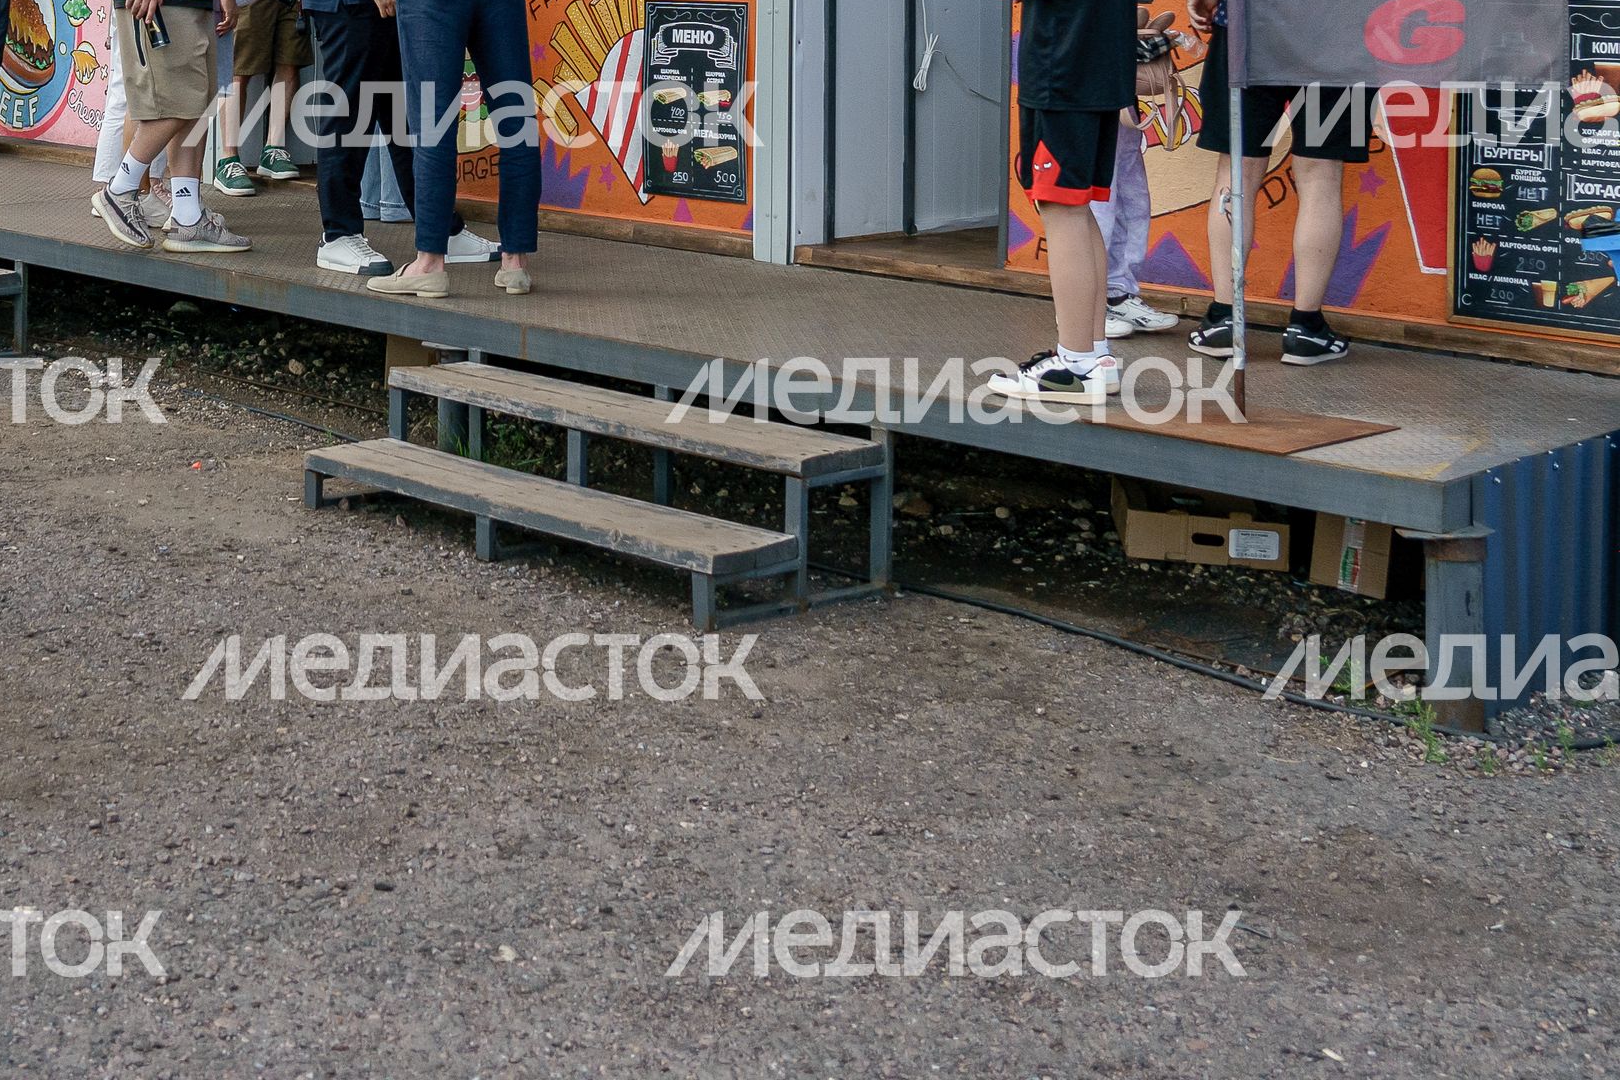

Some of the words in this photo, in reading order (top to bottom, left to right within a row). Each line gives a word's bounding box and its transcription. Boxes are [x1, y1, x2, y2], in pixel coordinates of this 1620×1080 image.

[672, 29, 715, 45] МЕНЮ
[1592, 41, 1620, 54] КОМ
[1483, 146, 1543, 162] БУРГЕРЫ
[672, 171, 689, 182] 250
[714, 170, 737, 183] 500
[1499, 241, 1541, 251] КАРТОФЕЛЬ
[1542, 246, 1558, 254] ФРИ
[1468, 273, 1488, 281] КВАС
[1493, 275, 1529, 287] ЛИМОНАД
